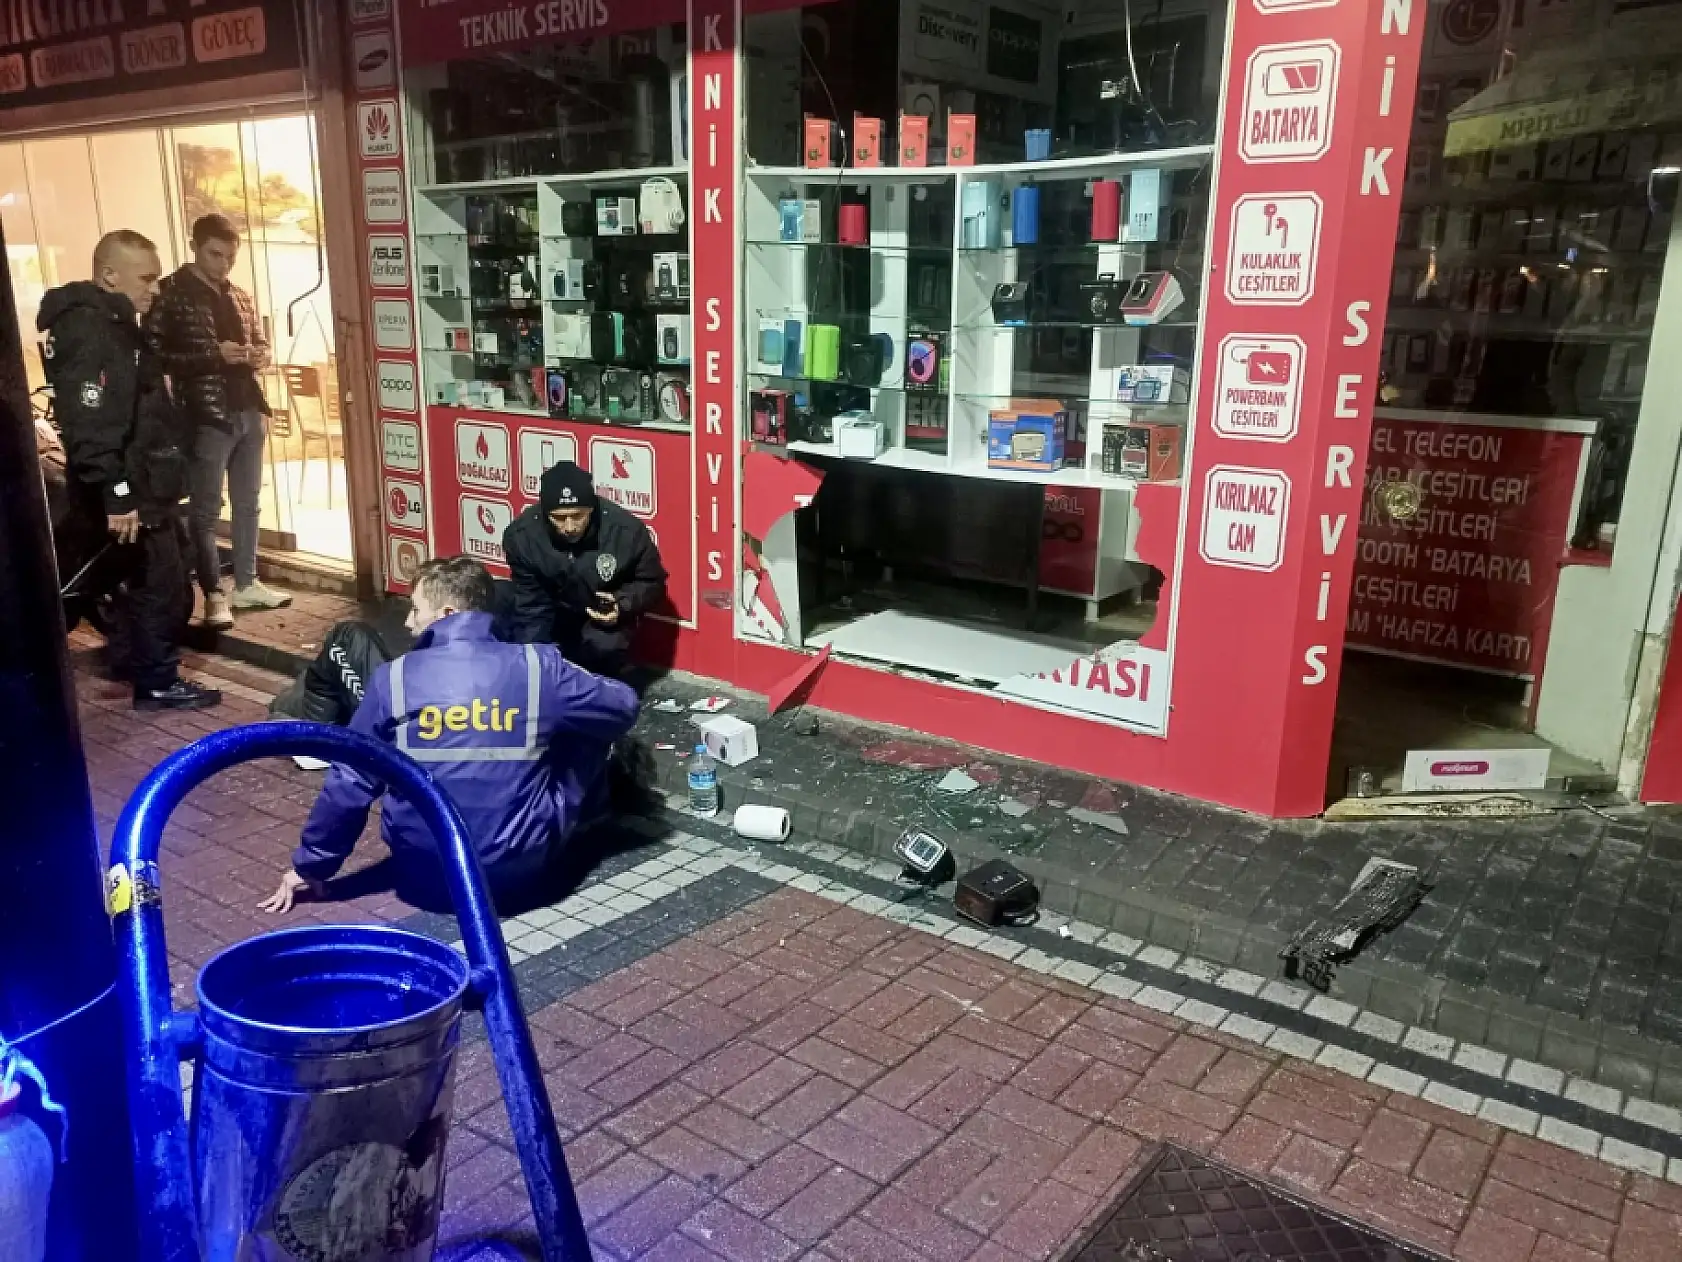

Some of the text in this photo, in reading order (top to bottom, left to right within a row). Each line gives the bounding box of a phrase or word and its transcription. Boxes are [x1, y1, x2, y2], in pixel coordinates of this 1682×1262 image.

[459, 4, 529, 48] TEKNİK
[1250, 105, 1319, 145] BATARYA
[1240, 252, 1302, 269] KULAKLIK
[1238, 271, 1301, 294] ÇEŞİTLERİ
[1225, 387, 1287, 408] POWERBANK
[1230, 408, 1280, 428] ÇEŞİTLERİ
[705, 297, 723, 581] SERVİS
[1403, 430, 1503, 463] TELEFON
[1215, 481, 1277, 516] KIRILMAZ
[1302, 301, 1371, 685] SERVİS
[1227, 523, 1256, 553] CAM
[1355, 573, 1460, 612] ÇEŞİTLERİ
[1465, 628, 1532, 663] KARTI
[416, 697, 520, 741] getir
